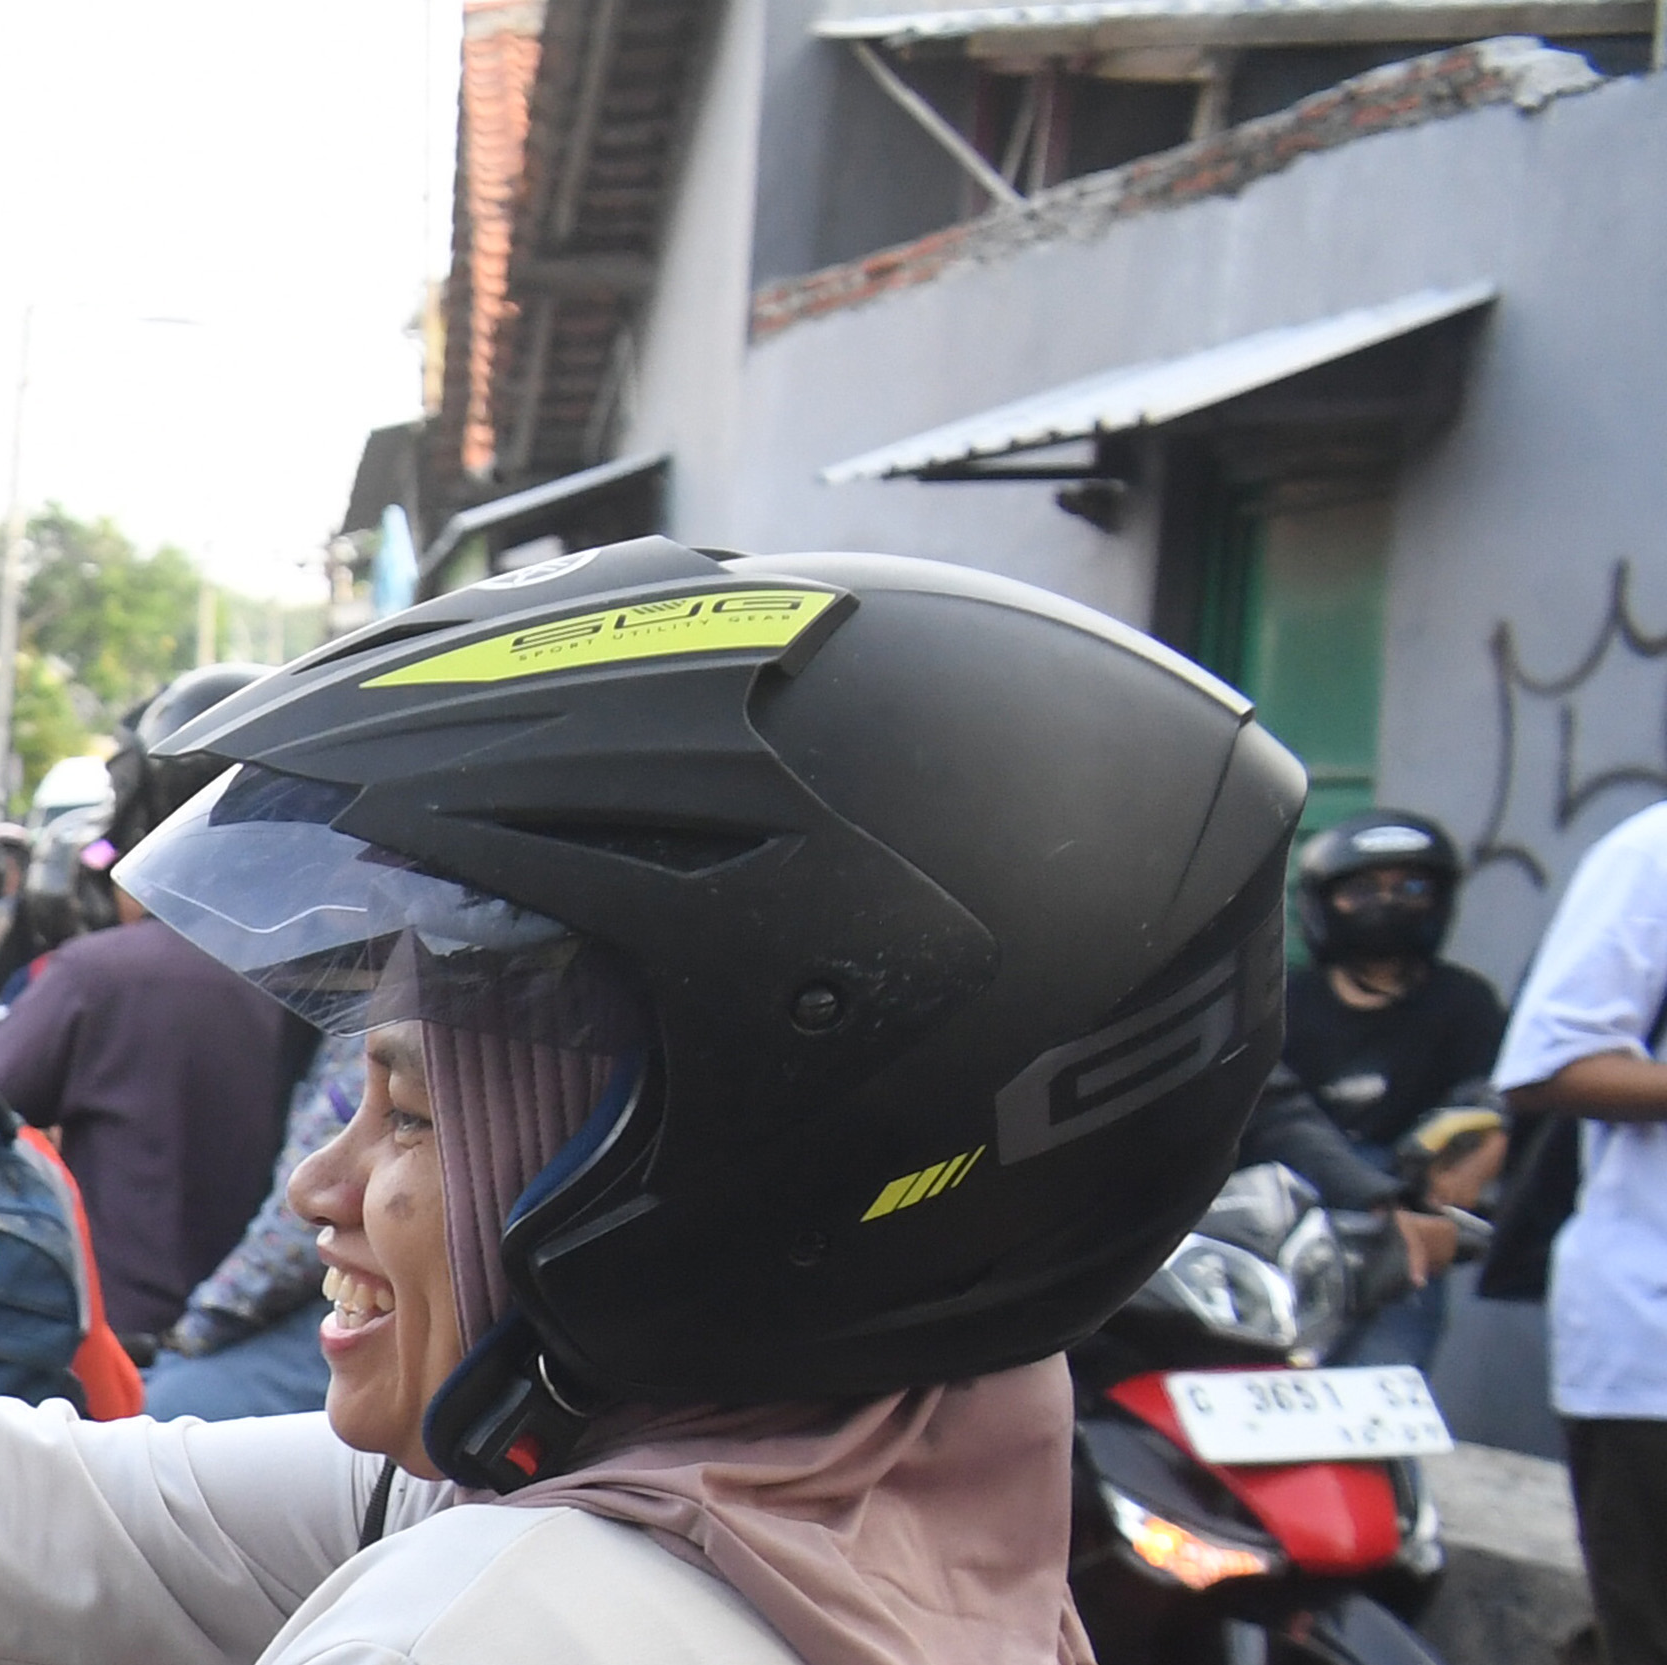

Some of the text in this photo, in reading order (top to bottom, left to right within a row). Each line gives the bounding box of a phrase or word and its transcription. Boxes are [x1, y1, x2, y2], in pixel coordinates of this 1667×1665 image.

[518, 613, 790, 661] SPORT UTILITY GEAR
